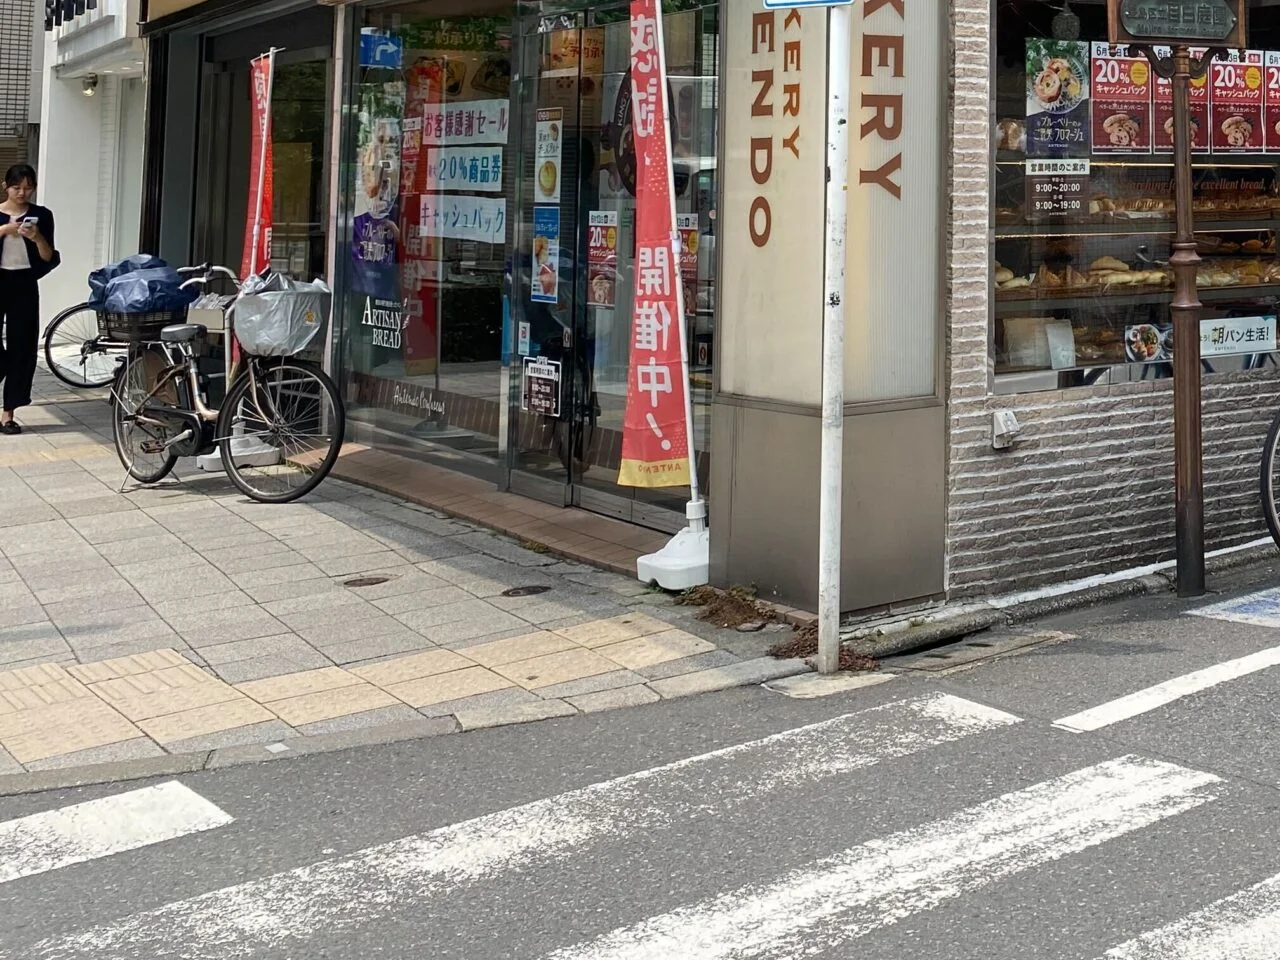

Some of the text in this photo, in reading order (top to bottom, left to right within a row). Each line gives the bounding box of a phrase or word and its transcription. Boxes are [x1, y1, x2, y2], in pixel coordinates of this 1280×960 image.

[1096, 46, 1121, 57] 6月日
[1095, 59, 1130, 84] 20%
[1214, 66, 1245, 88] 20%
[1096, 85, 1147, 95] キャッシュバック
[1215, 89, 1259, 98] キャッシュバック
[424, 108, 507, 138] お客様感謝セール
[1030, 163, 1086, 172] 営業時間のご案内
[1200, 178, 1238, 190] excellent
[421, 203, 504, 233] キャッシュバック
[372, 328, 401, 349] BREAD
[1212, 325, 1269, 345] 朝パン生活!
